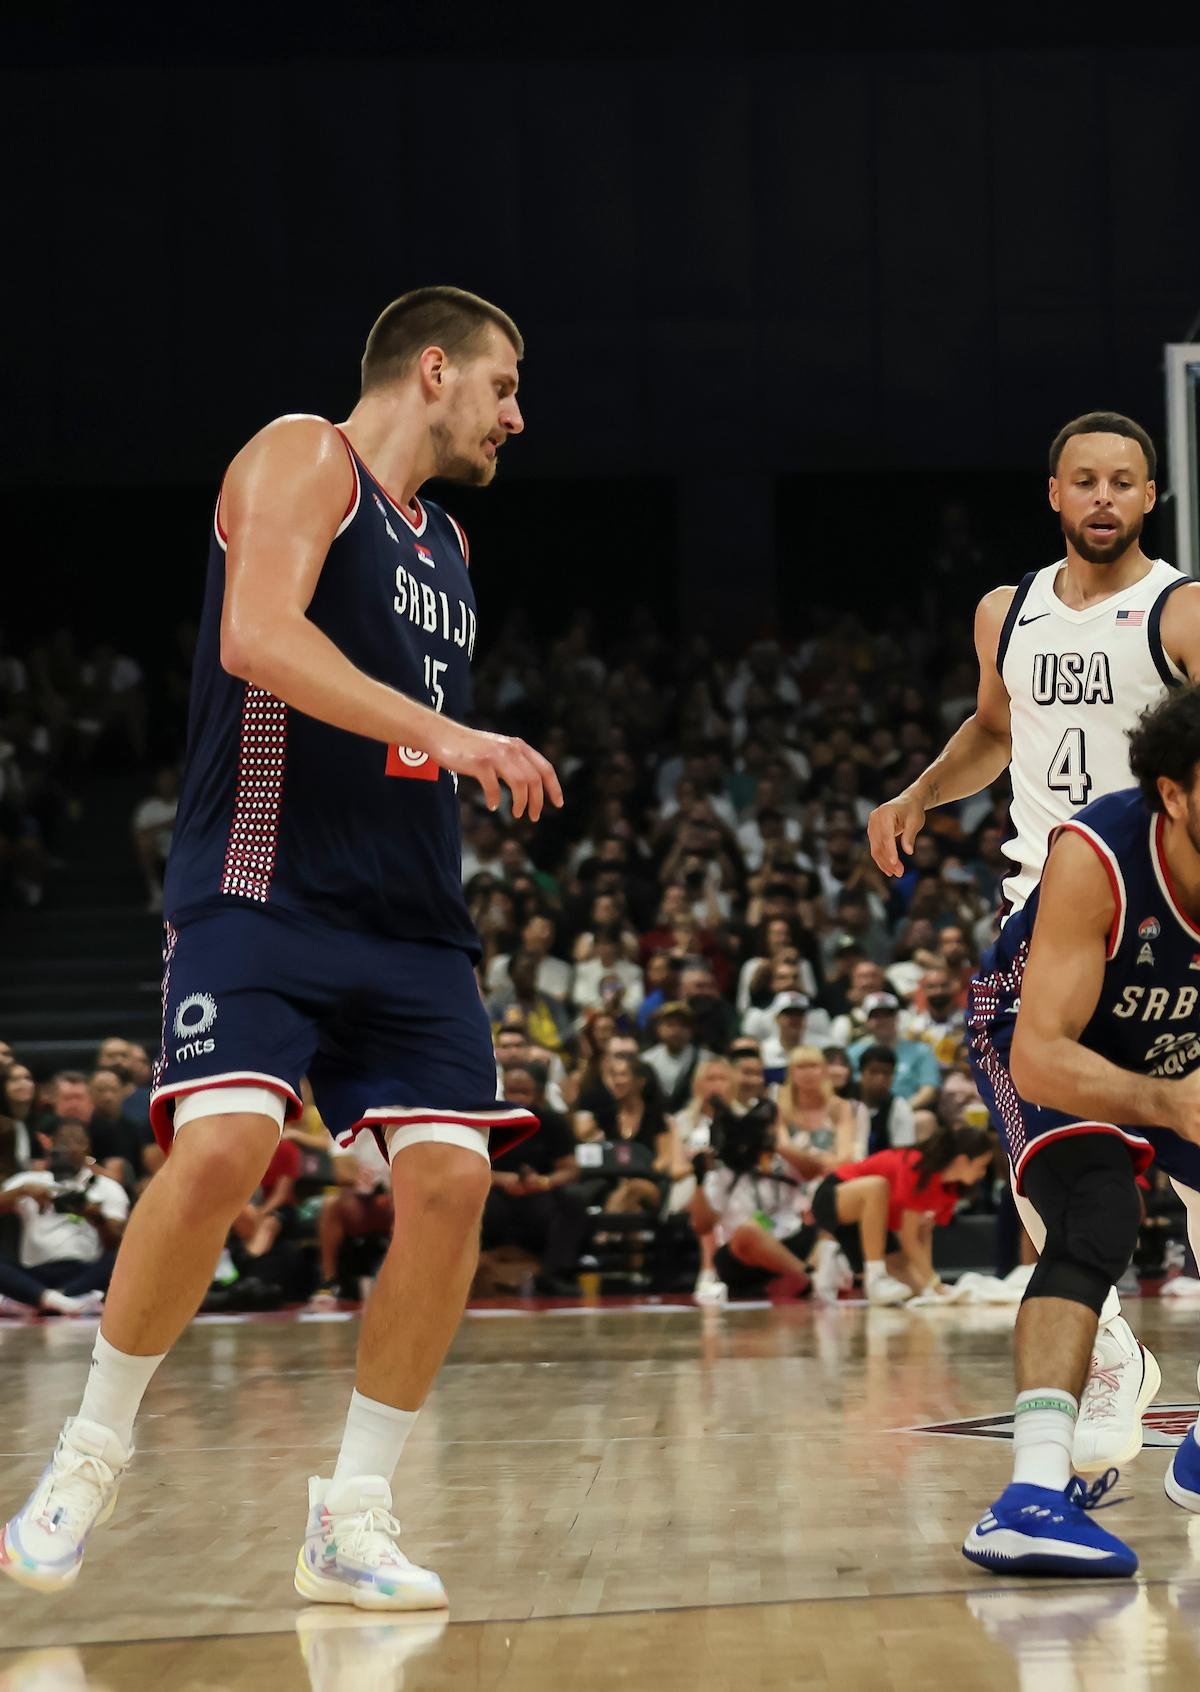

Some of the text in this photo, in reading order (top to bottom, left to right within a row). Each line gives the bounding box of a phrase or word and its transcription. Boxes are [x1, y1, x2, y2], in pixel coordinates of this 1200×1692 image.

[424, 655, 448, 713] 15
[1032, 652, 1114, 705] USA
[1047, 728, 1092, 805] 4
[176, 1039, 215, 1063] mts
